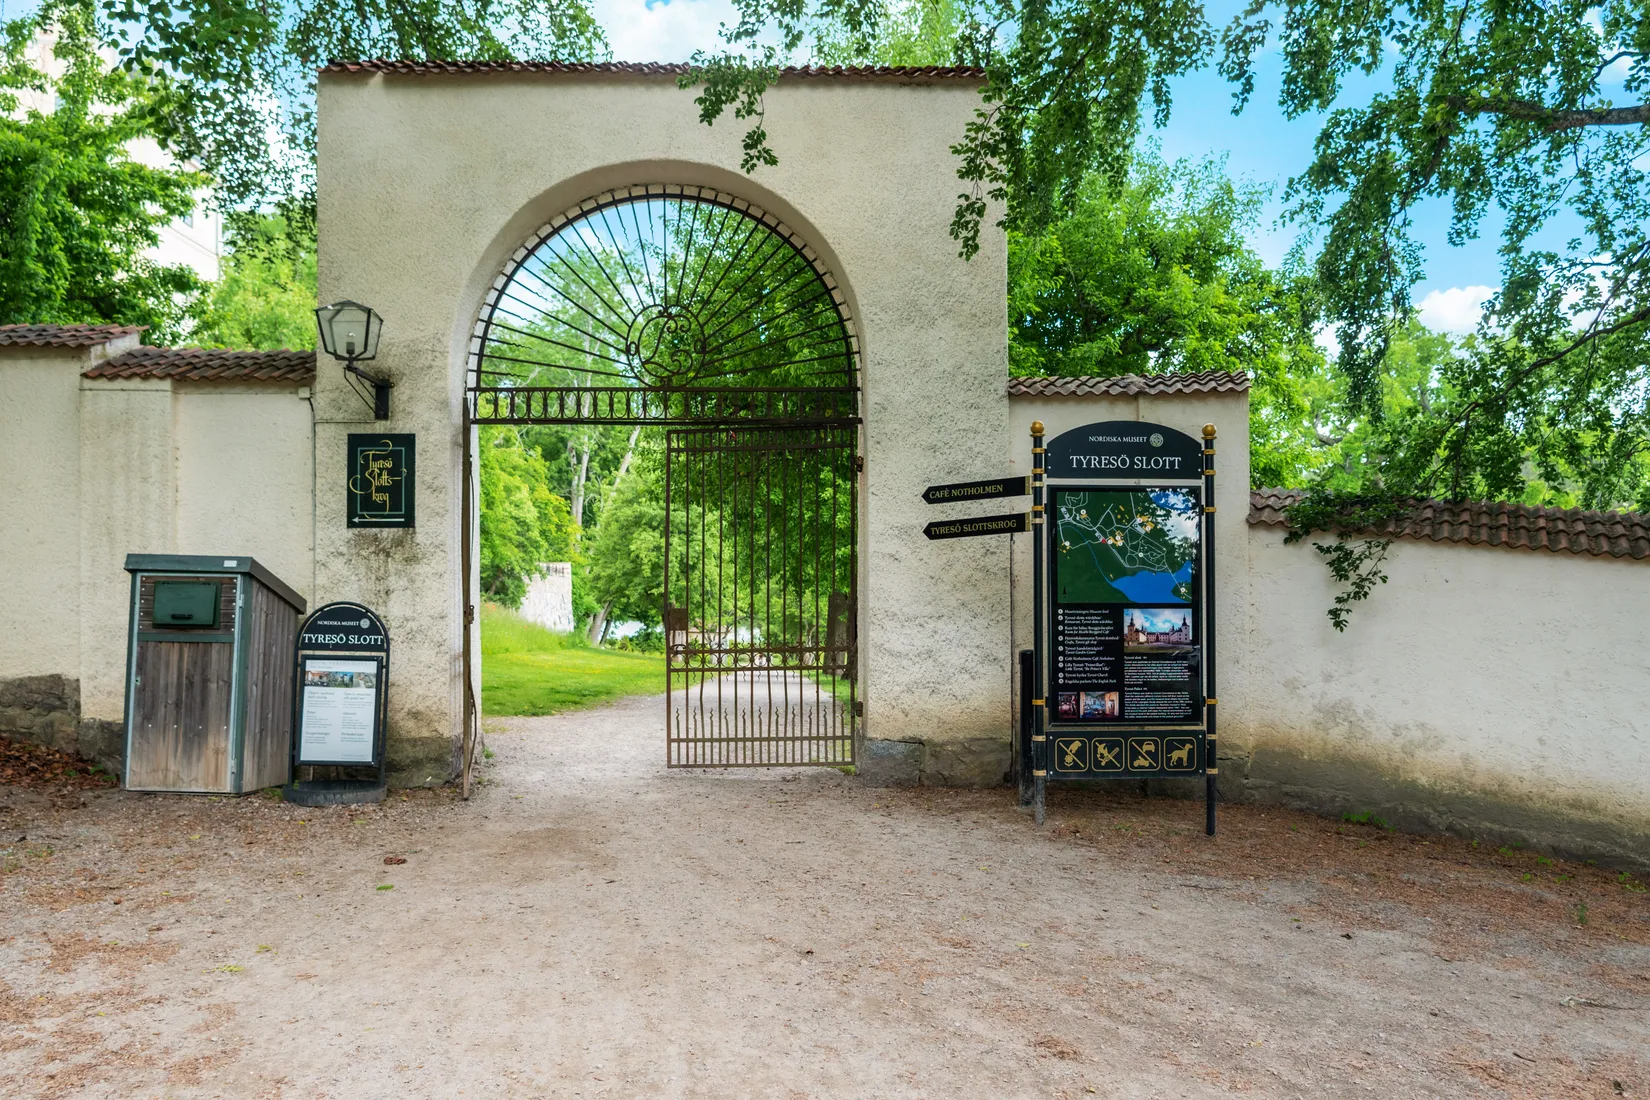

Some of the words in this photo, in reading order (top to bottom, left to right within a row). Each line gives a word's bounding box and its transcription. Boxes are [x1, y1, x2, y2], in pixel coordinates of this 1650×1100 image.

[1070, 454, 1130, 469] TYRESÖ
[1134, 456, 1182, 469] SLOTT
[951, 484, 1004, 497] NOTHOLMEN
[930, 523, 962, 536] TYRESÖ
[963, 520, 1017, 533] SLOTTSKROG
[303, 633, 346, 644] TYRESÖ
[348, 635, 384, 645] SLOTT
